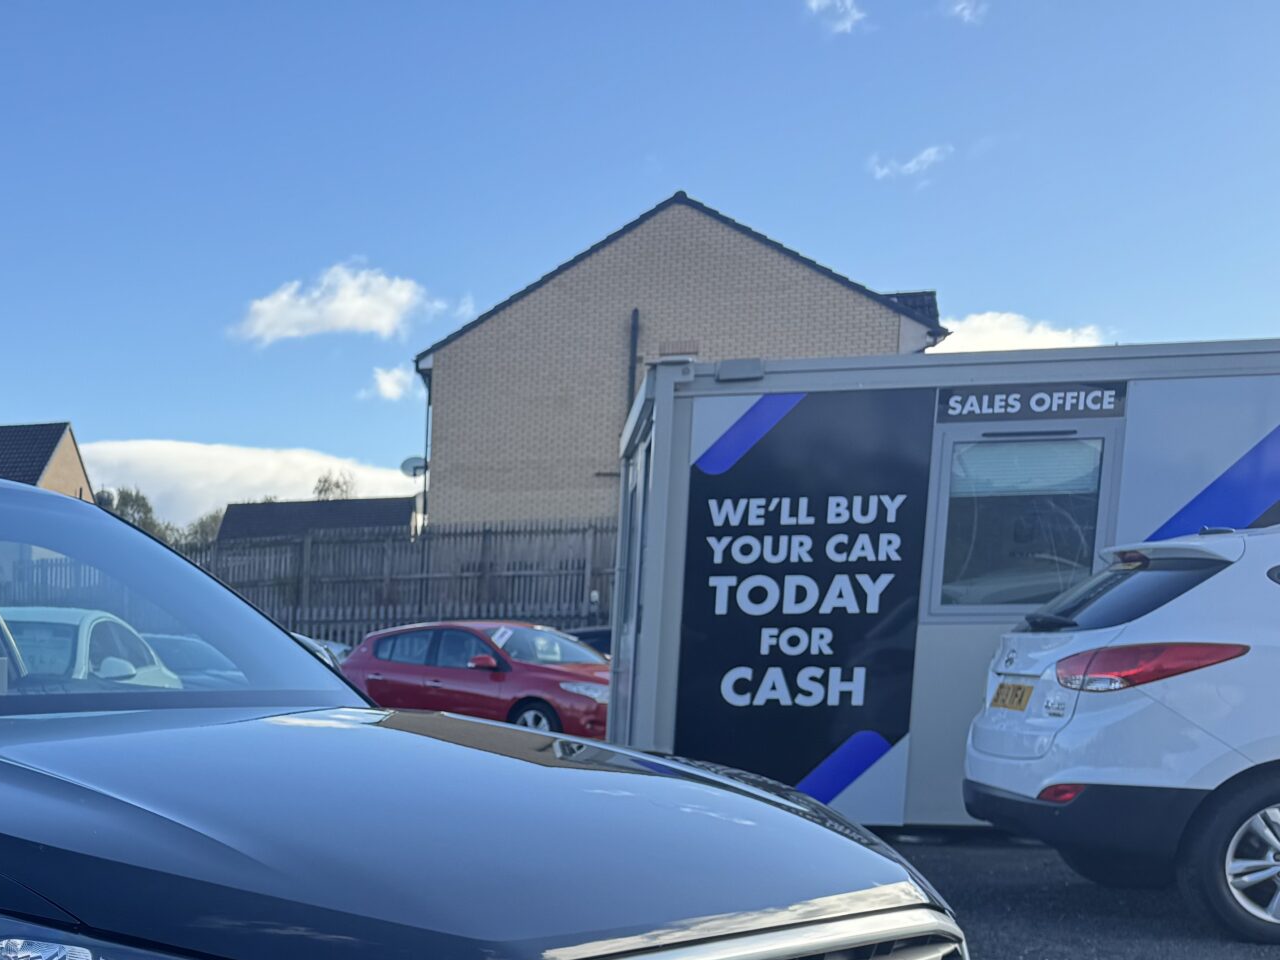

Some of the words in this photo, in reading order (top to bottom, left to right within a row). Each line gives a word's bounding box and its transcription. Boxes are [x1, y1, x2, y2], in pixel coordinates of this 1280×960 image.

[948, 394, 1022, 415] SALES
[1029, 390, 1116, 413] OFFICE
[708, 497, 815, 527] WE'LL
[827, 495, 908, 524] BUY
[706, 534, 814, 564] YOUR
[825, 532, 902, 563] CAR
[708, 573, 895, 616] TODAY
[759, 627, 834, 656] FOR
[720, 666, 867, 707] CASH
